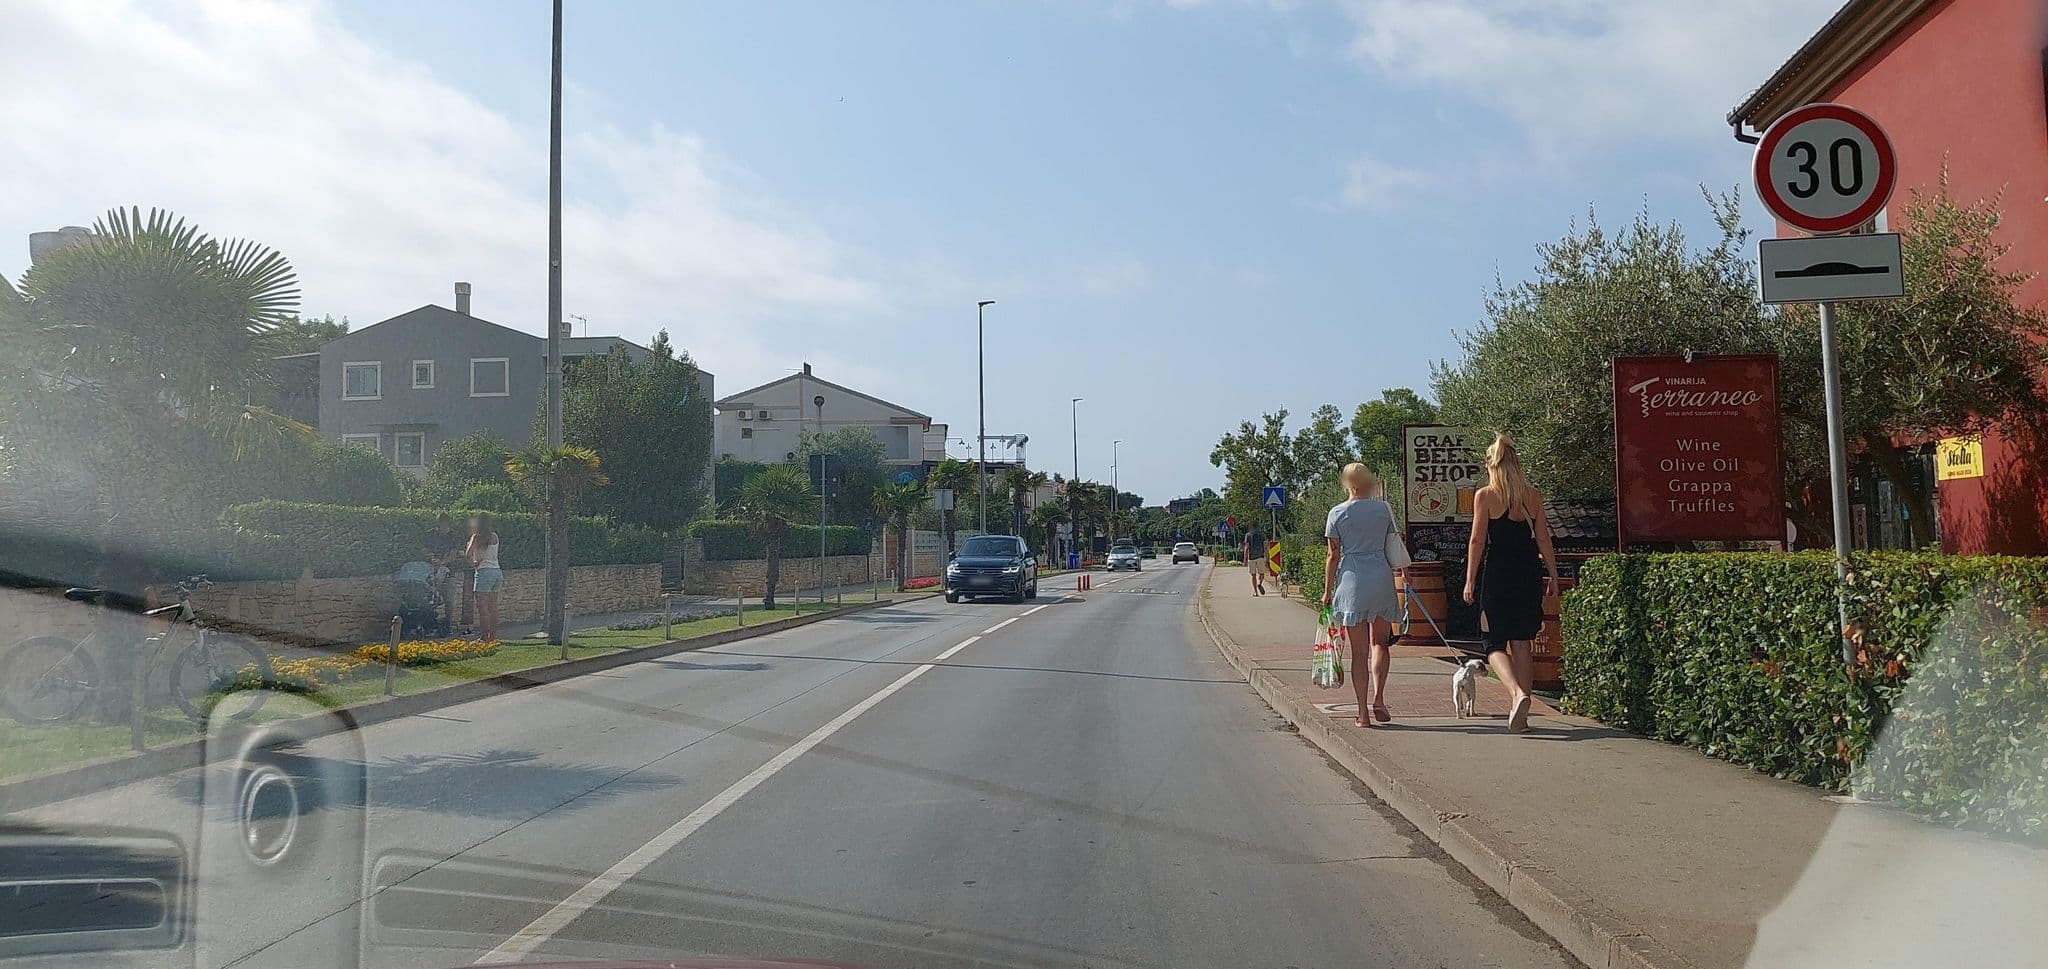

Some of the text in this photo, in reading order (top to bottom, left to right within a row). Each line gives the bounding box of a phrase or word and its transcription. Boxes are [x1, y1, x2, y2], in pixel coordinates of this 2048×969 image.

[1786, 137, 1863, 198] 30
[1665, 377, 1707, 385] VINARIJA
[1629, 376, 1763, 418] Terraneo
[1676, 438, 1721, 451] Wine
[1660, 457, 1738, 472] Olive Oil
[1947, 447, 1971, 466] Stella
[1414, 464, 1480, 482] SHOP
[1668, 479, 1732, 496] Grappa
[1668, 498, 1735, 512] Truffles
